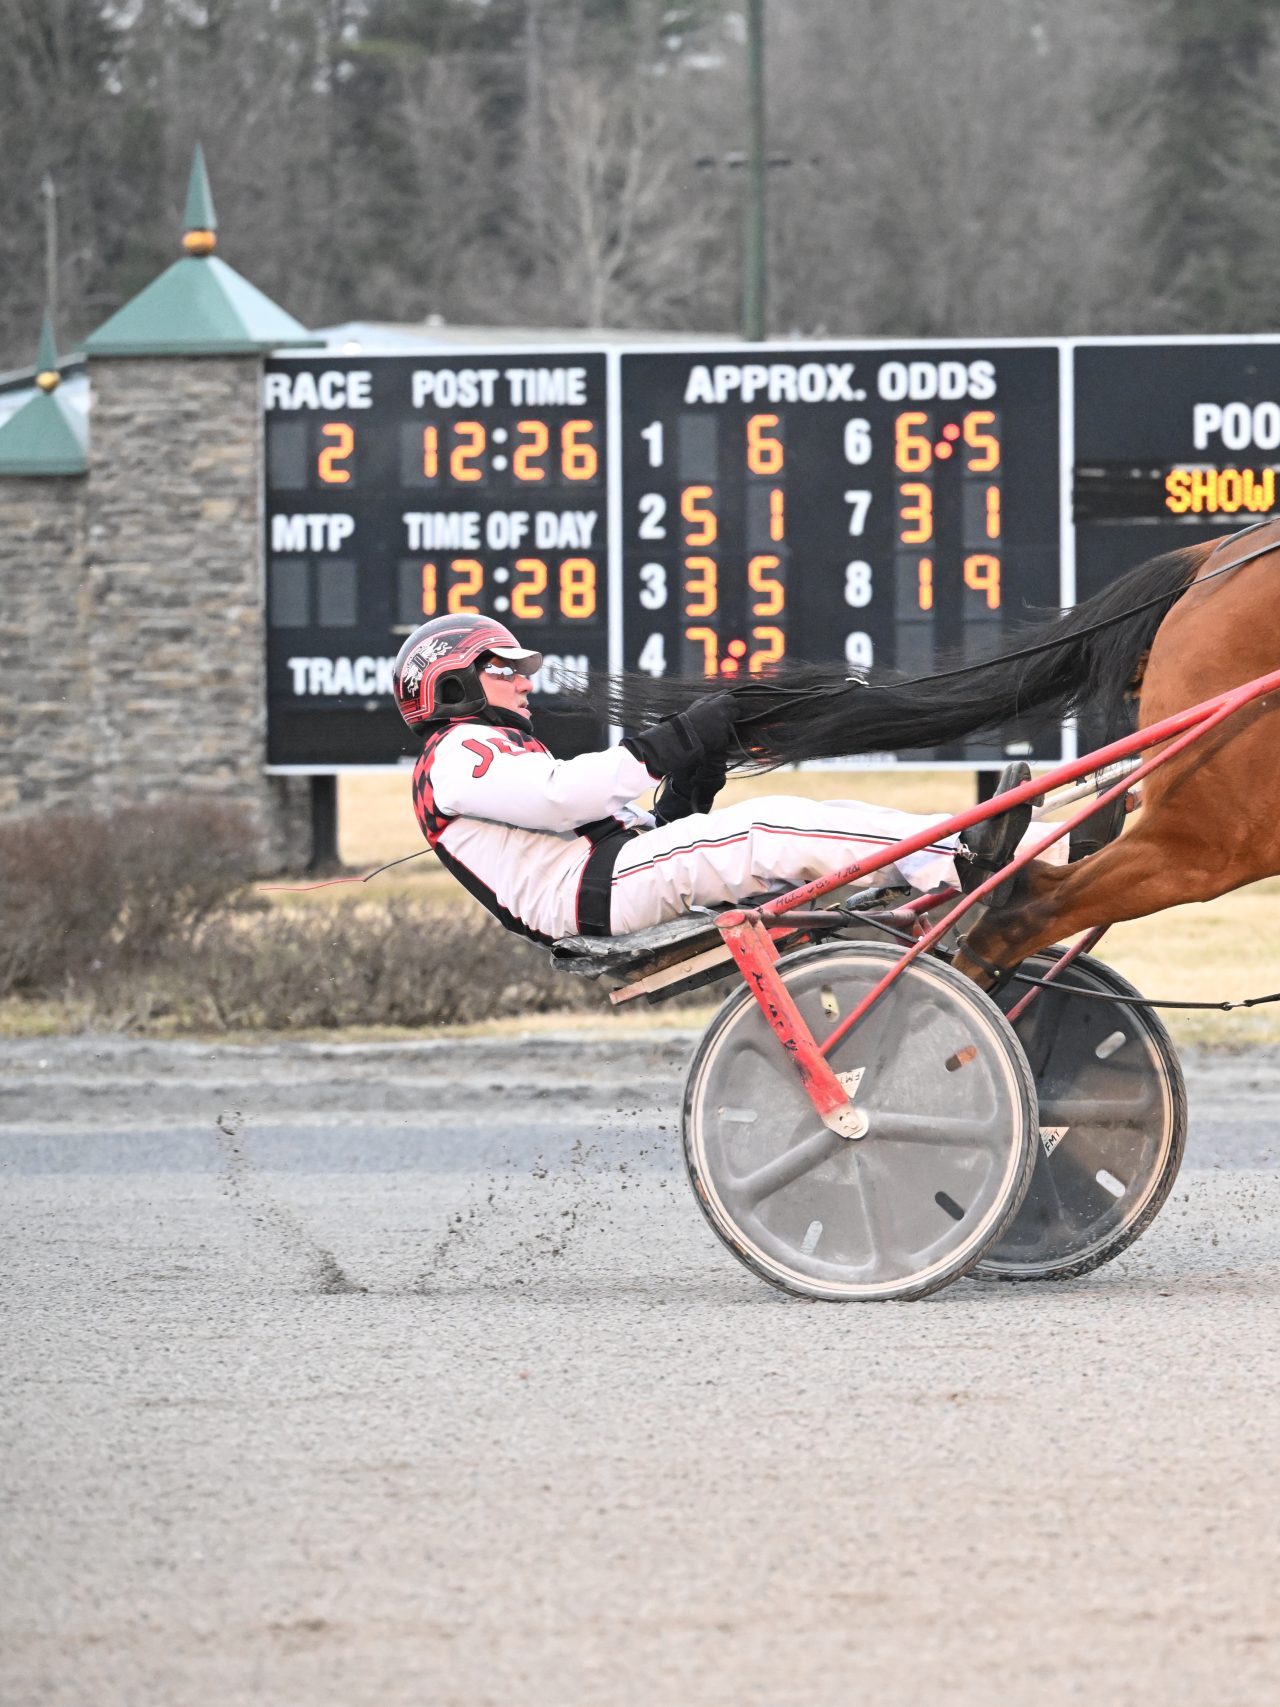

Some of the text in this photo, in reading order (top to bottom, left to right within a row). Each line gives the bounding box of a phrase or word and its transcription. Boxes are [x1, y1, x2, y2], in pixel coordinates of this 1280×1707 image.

[265, 371, 373, 410] RACE
[412, 367, 587, 409] POST TIME
[685, 361, 997, 404] APPROX. ODDS
[318, 422, 355, 483] 2
[423, 419, 598, 482] 12:26
[640, 414, 784, 475] 1 6
[843, 417, 873, 465] 6
[843, 489, 873, 537] 7
[1165, 468, 1276, 513] SHOW
[271, 513, 355, 552] MTP
[402, 510, 598, 551] TIME OF DAY
[639, 492, 667, 540] 2
[422, 557, 596, 619] 12:28
[639, 562, 668, 610] 3
[844, 560, 873, 608] 8
[287, 655, 396, 696] TRACK
[638, 632, 667, 679] 4
[844, 631, 874, 676] 9
